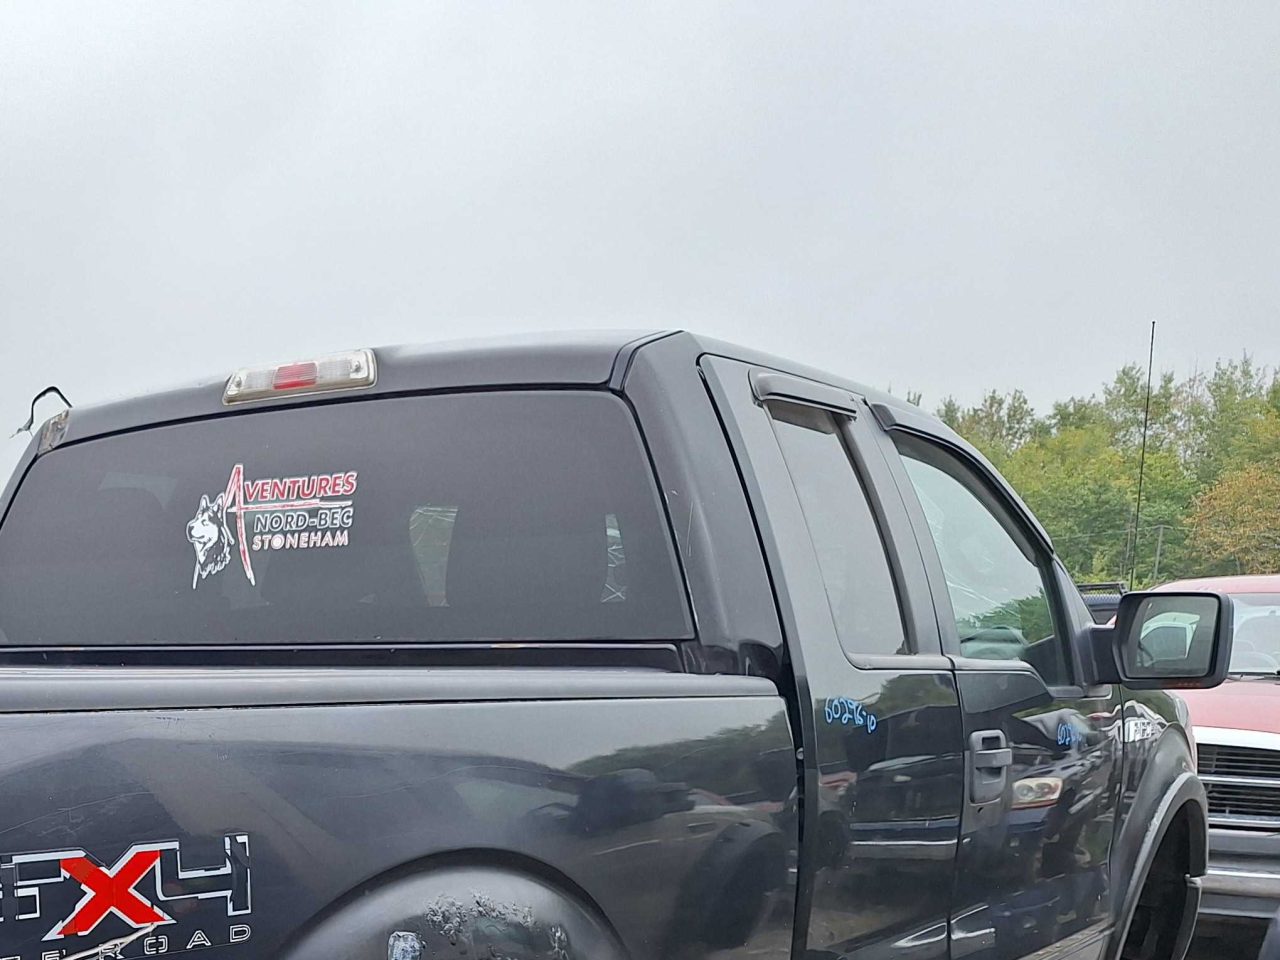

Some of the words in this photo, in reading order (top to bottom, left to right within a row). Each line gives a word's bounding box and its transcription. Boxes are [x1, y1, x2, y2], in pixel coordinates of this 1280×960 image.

[221, 463, 358, 586] AVENTURES
[253, 507, 353, 532] NORD-BEC
[252, 530, 349, 551] STONEHAM
